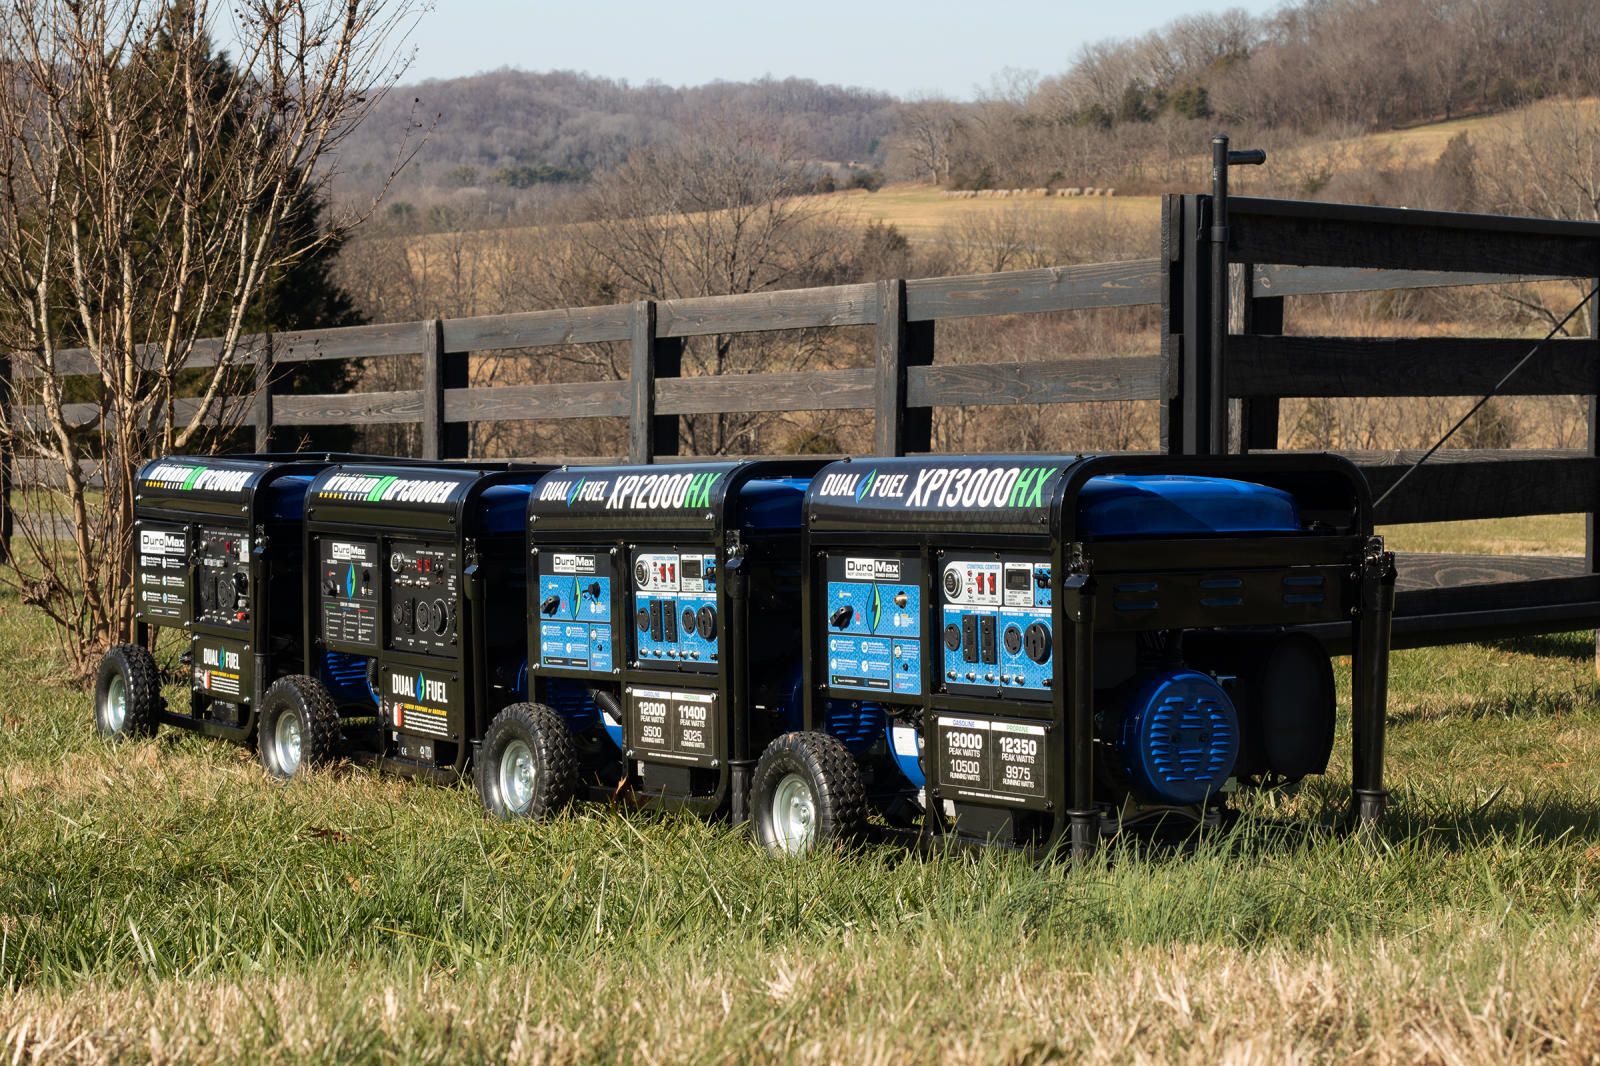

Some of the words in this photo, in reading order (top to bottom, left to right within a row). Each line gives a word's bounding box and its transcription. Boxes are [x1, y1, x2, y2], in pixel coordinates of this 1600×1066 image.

[323, 476, 380, 493] HYBRID
[540, 481, 572, 501] DUAL
[578, 481, 608, 501] FUEL
[606, 473, 722, 509] XP12000HX
[819, 474, 860, 497] DUAL
[870, 474, 909, 497] FUEL
[905, 468, 1058, 507] XP13000HX
[343, 492, 368, 501] ELITE
[143, 534, 185, 548] DuroMax
[334, 545, 366, 555] DuroMax
[555, 556, 594, 567] DuroMax
[847, 561, 898, 572] DuroMax
[204, 648, 219, 666] DUAL
[226, 651, 240, 670] FUEL
[392, 674, 416, 697] DUAL
[426, 680, 448, 703] FUEL
[638, 702, 666, 716] 12000
[678, 705, 706, 720] 11400
[651, 716, 664, 724] WATTS
[691, 720, 705, 728] WATTS
[644, 726, 662, 737] 9500
[683, 729, 702, 742] 9025
[1006, 725, 1028, 733] PROPANE
[946, 731, 982, 750] 13000
[999, 737, 1037, 755] 12350
[948, 747, 962, 756] PEAK
[962, 749, 980, 758] WATTS
[1002, 753, 1015, 761] PEAK
[1016, 755, 1035, 764] WATTS
[950, 759, 980, 774] 10500
[1006, 765, 1030, 780] 9975
[967, 773, 980, 782] WATTS
[1002, 778, 1020, 786] RUNNING
[1020, 780, 1035, 788] WATTS
